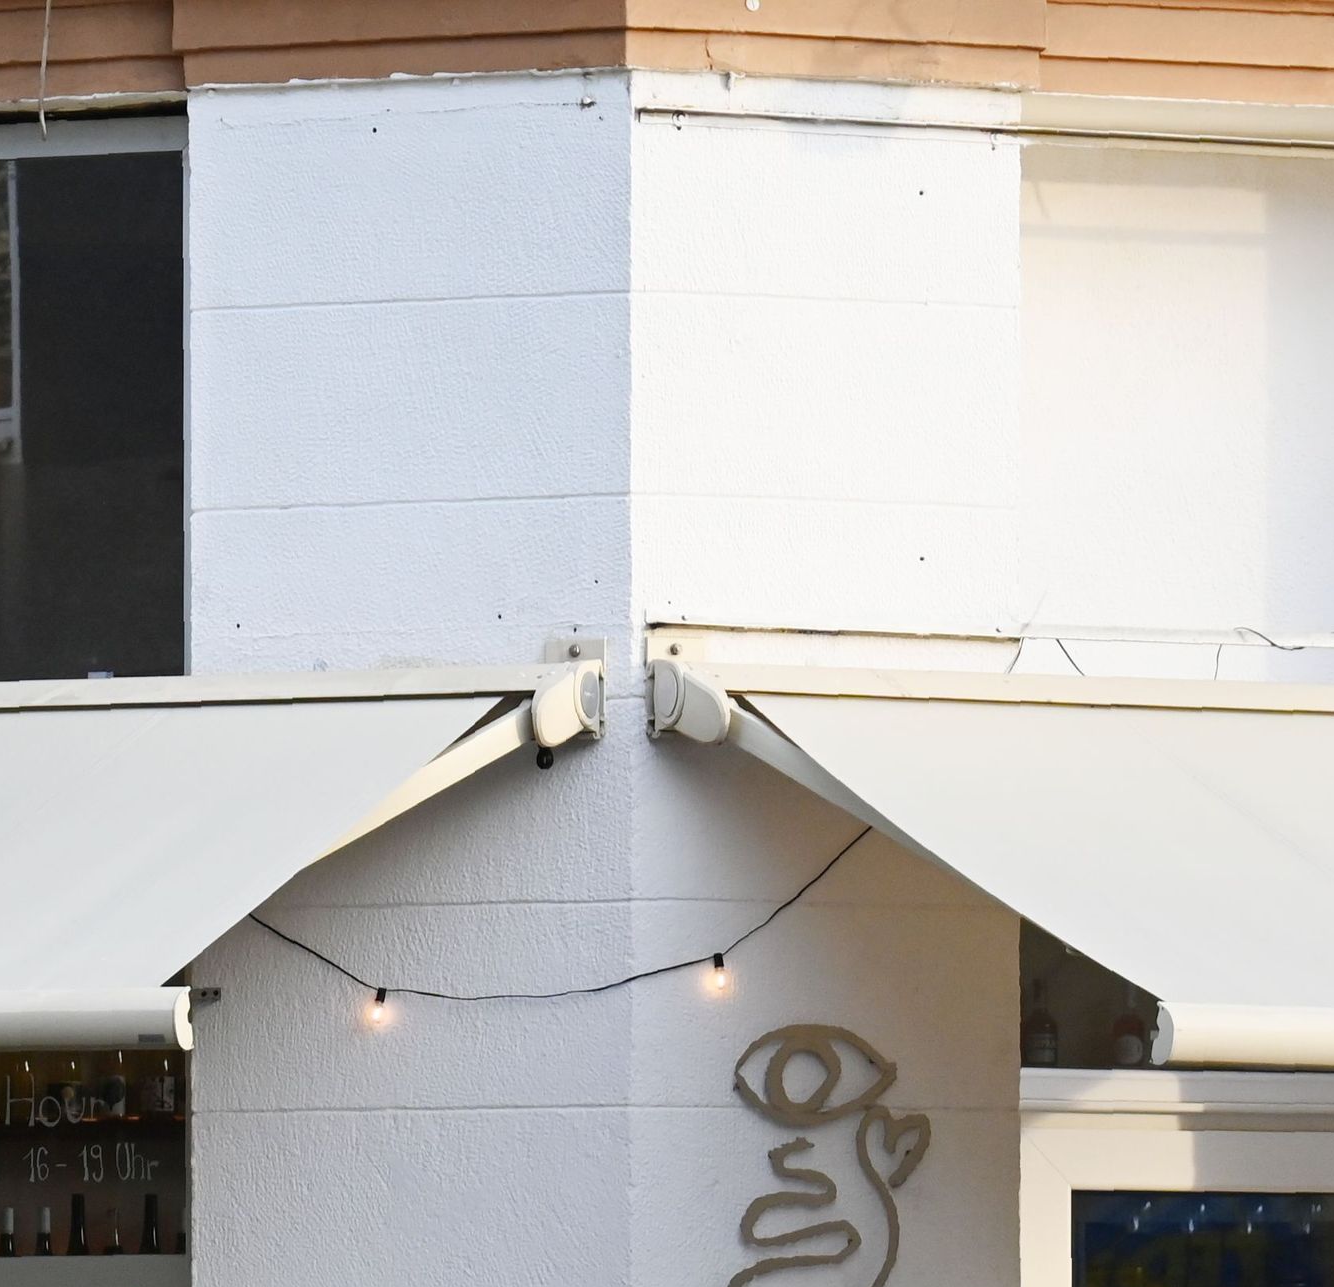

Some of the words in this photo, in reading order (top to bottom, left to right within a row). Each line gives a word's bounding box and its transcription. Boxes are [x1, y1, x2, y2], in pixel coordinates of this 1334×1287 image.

[5, 1075, 107, 1128] Hour
[78, 1144, 106, 1183] 19
[115, 1142, 161, 1182] Uhr
